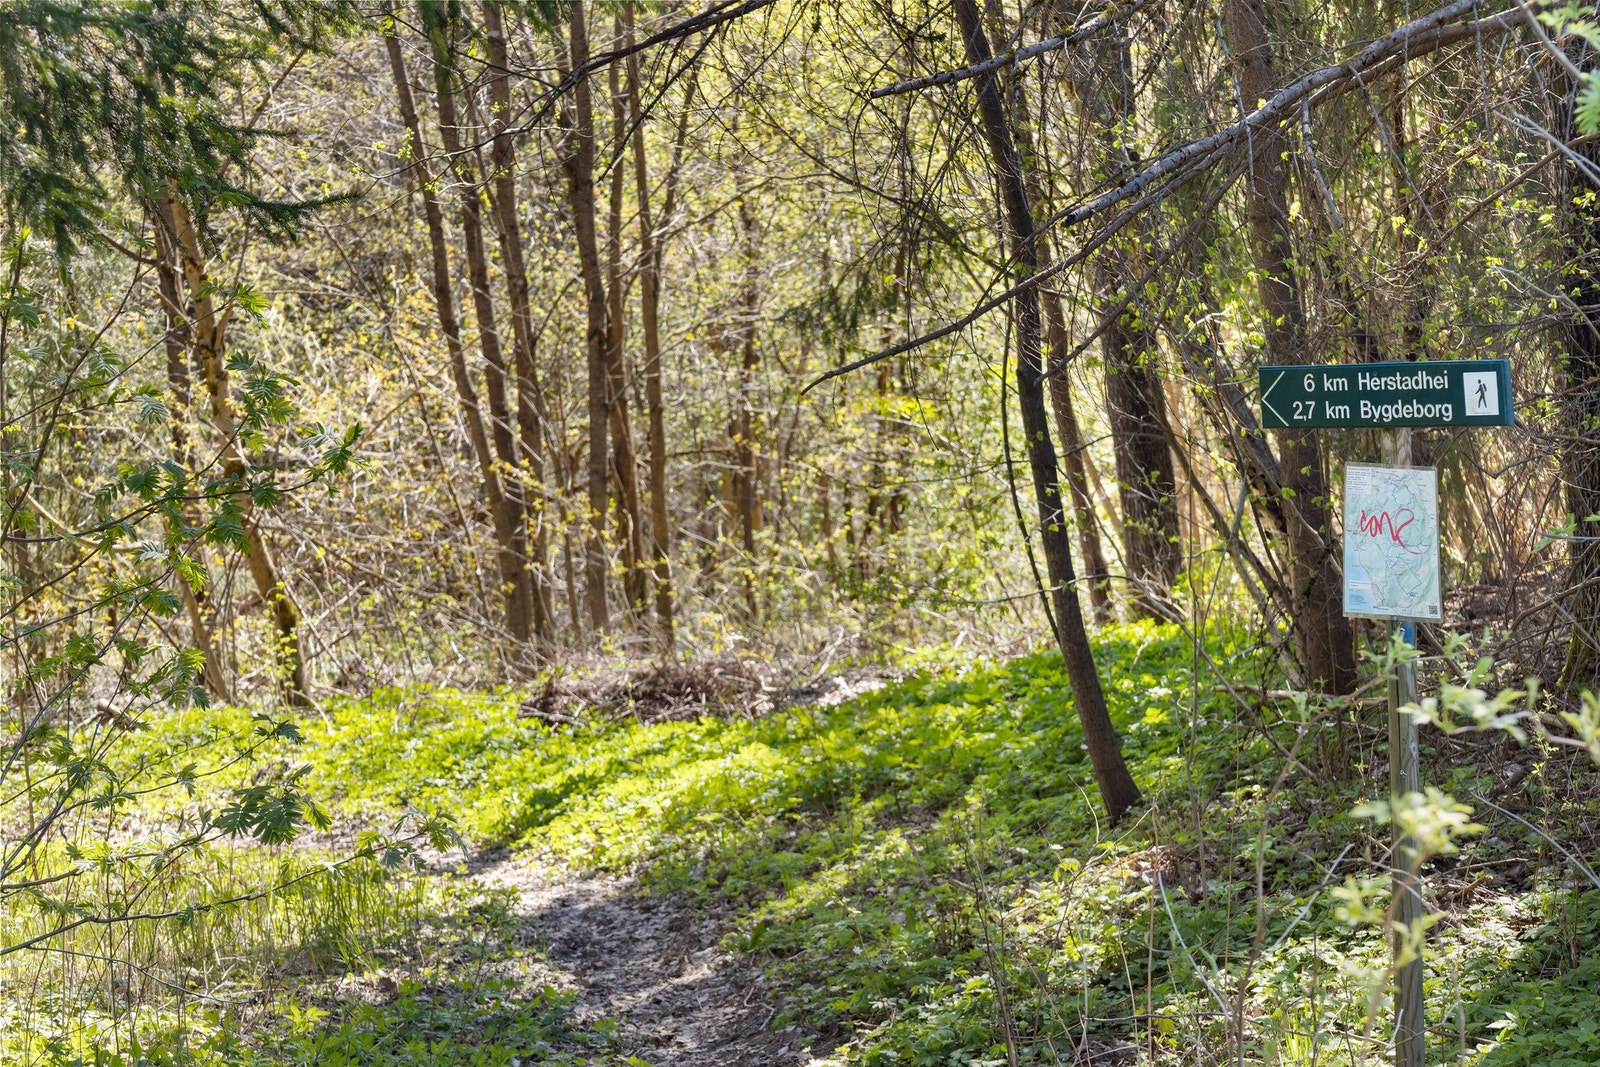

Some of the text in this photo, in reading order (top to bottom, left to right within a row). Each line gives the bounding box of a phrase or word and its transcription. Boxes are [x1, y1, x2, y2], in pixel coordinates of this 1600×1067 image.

[1303, 370, 1449, 393] 6 km Herstadhei
[1292, 399, 1453, 423] 2,7 km Bygdeborg
